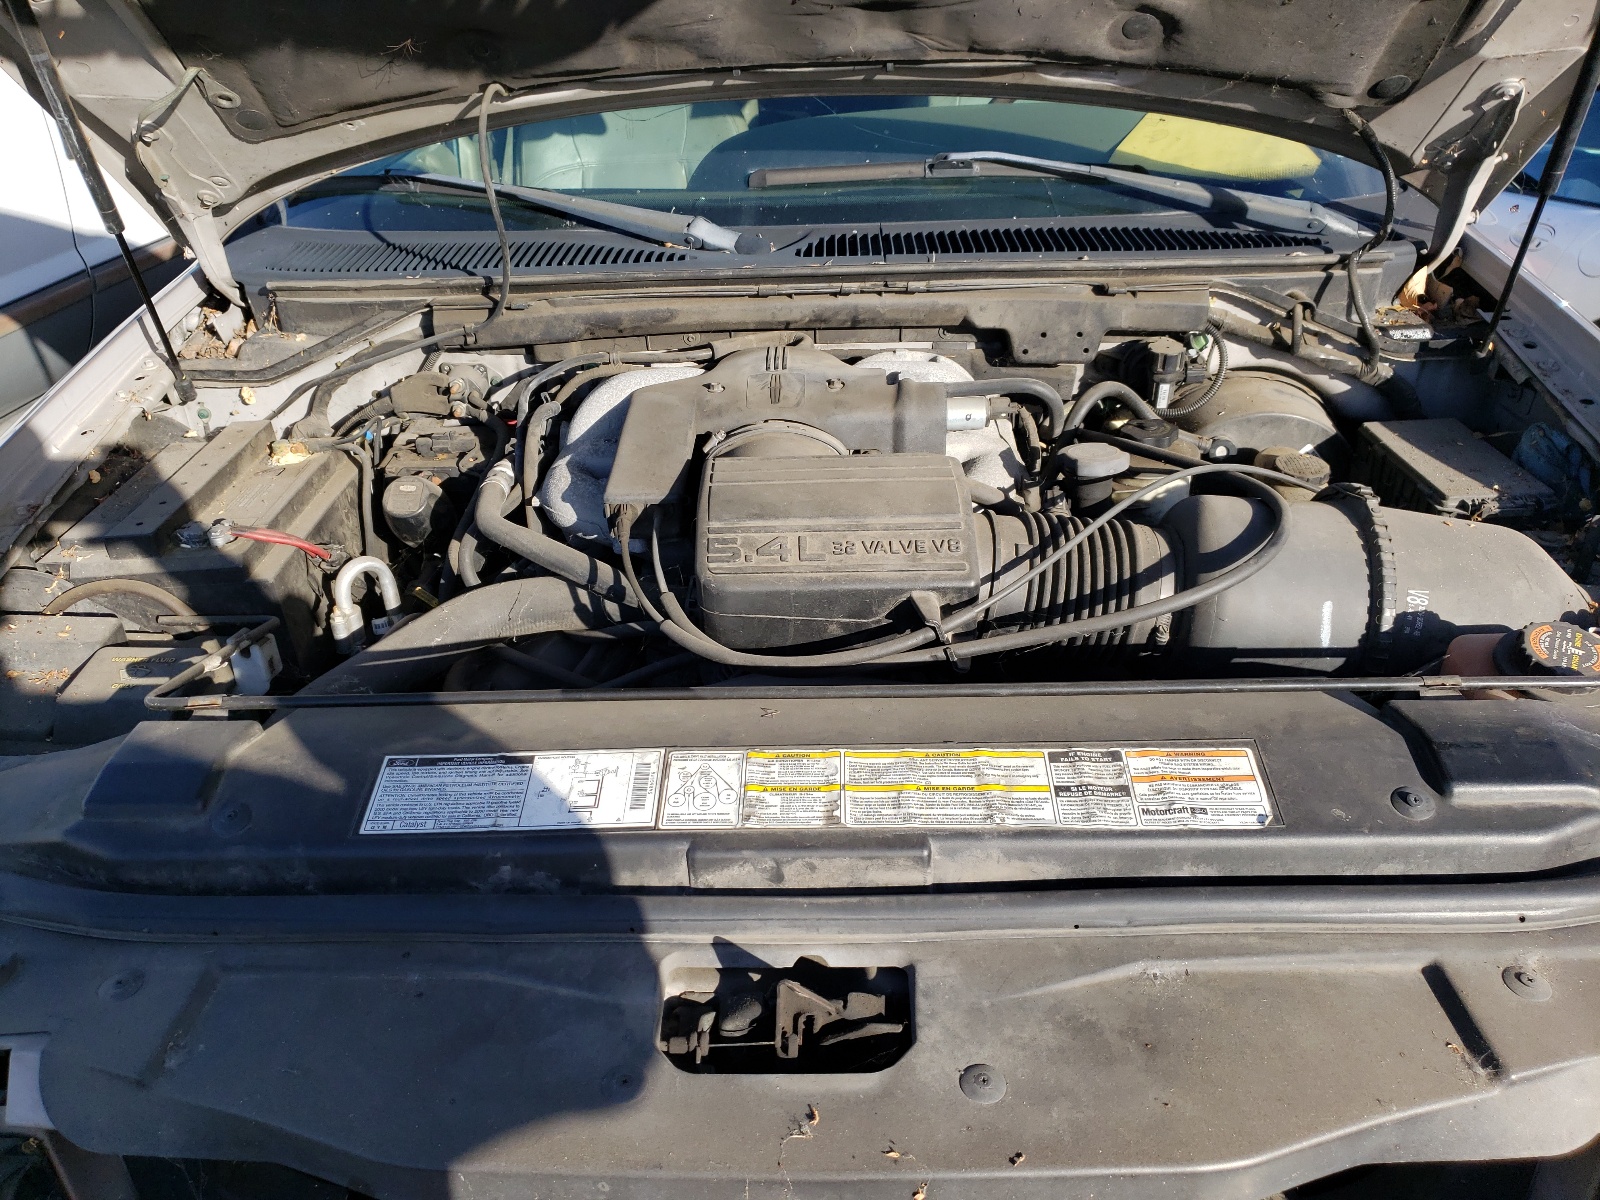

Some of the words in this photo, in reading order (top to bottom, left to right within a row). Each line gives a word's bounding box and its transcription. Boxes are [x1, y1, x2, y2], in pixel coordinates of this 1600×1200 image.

[706, 535, 827, 563] 5.4L
[832, 540, 857, 556] 32
[861, 539, 928, 555] VALVE
[931, 538, 962, 555] V8
[1407, 589, 1429, 606] V8
[1141, 806, 1190, 816] Motorcraft
[400, 820, 427, 829] Catalyst
